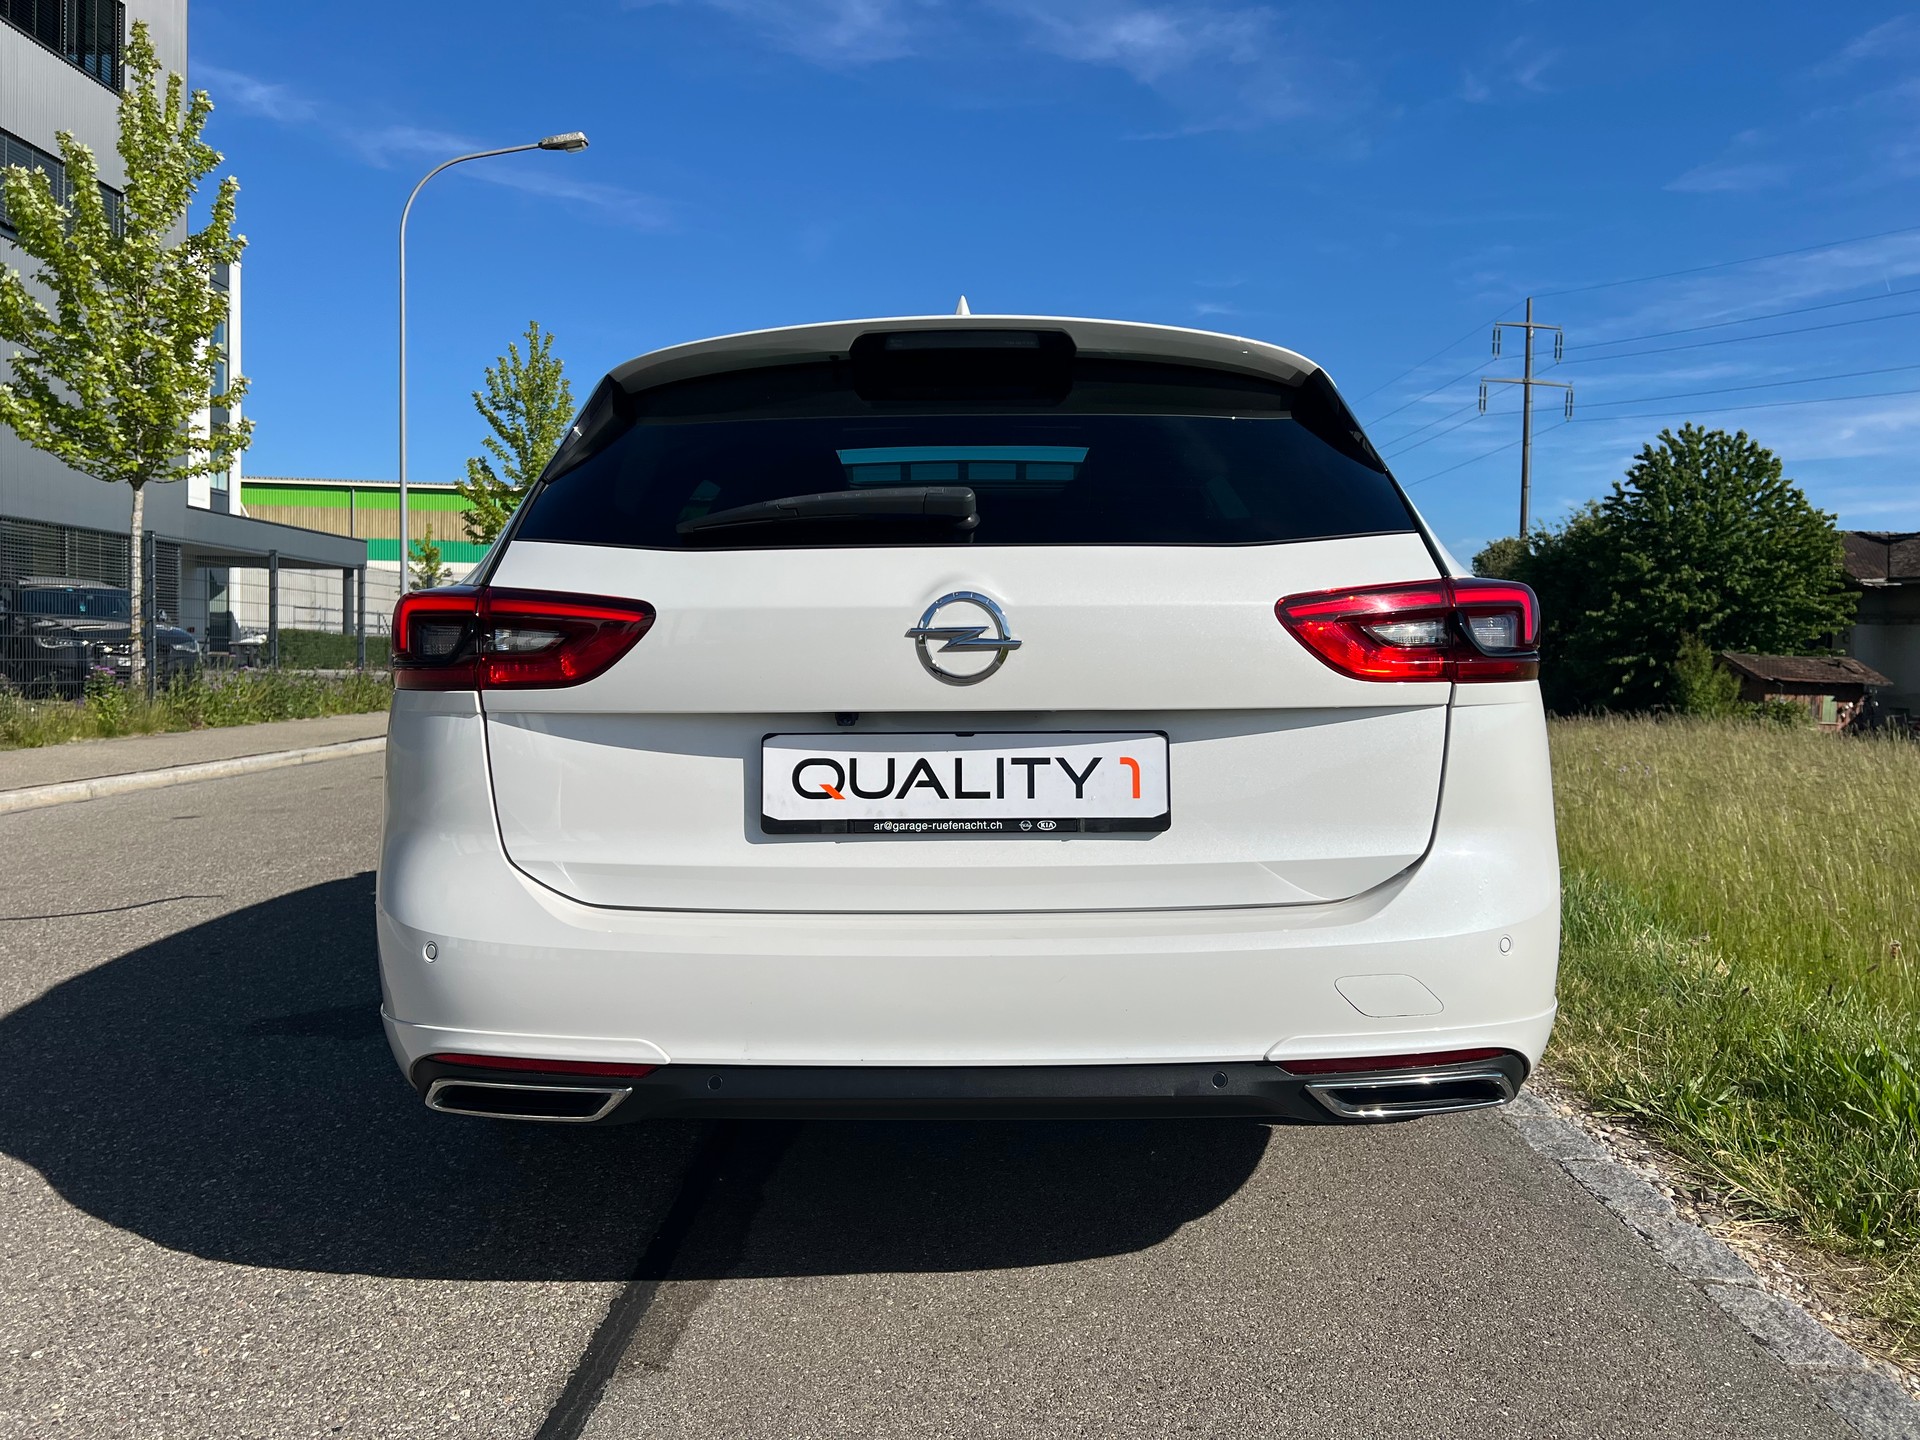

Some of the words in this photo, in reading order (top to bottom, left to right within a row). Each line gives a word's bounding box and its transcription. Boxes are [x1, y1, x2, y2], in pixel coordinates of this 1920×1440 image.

[792, 757, 1102, 799] QUALITY
[1119, 756, 1141, 799] 1
[873, 820, 1003, 832] ar@garage-ruefenacht.ch
